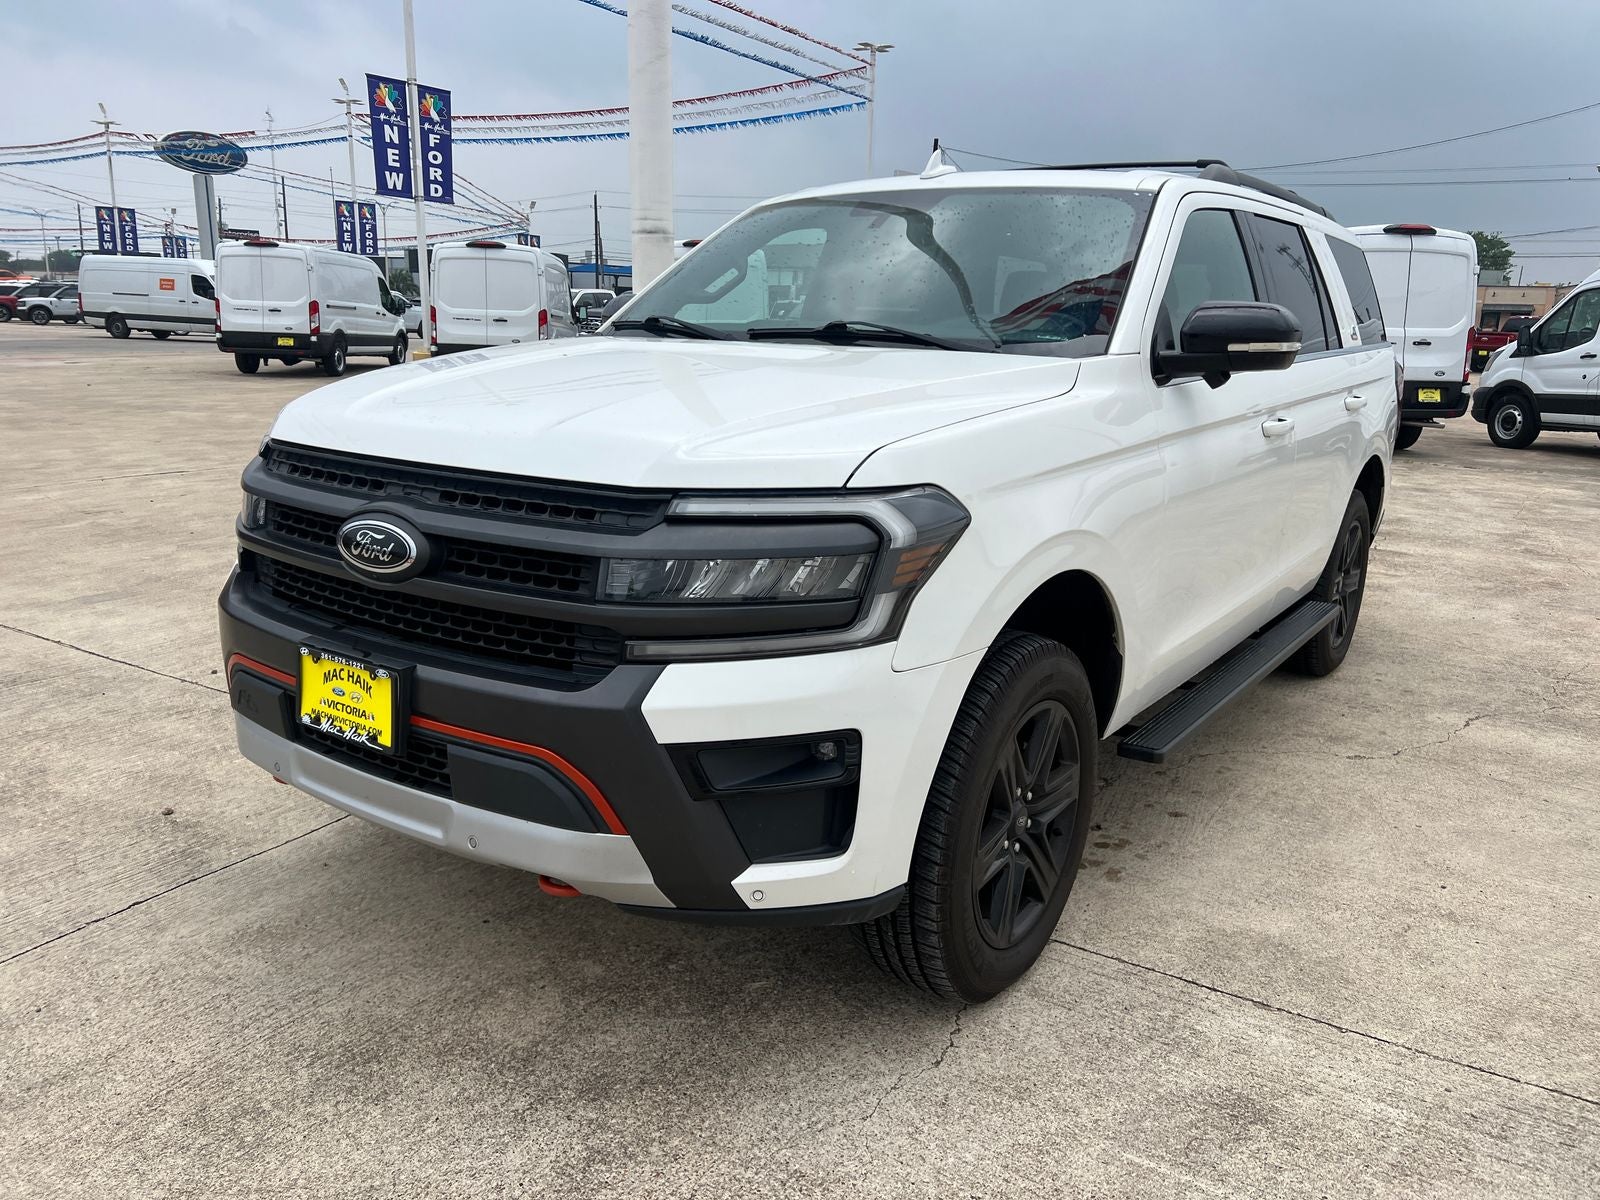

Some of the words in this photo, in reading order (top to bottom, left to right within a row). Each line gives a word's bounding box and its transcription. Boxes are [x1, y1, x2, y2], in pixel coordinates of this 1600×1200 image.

[383, 124, 404, 191] NEW
[427, 133, 443, 198] FORD
[102, 224, 113, 250] NEW
[124, 225, 134, 251] FORD
[342, 222, 353, 252] NEW
[365, 224, 374, 254] FORD
[351, 529, 395, 562] Ford
[323, 668, 345, 685] MAC
[347, 669, 373, 698] HAIK
[326, 698, 368, 720] VICTORIA
[319, 716, 343, 736] Mac
[343, 726, 370, 743] Haik
